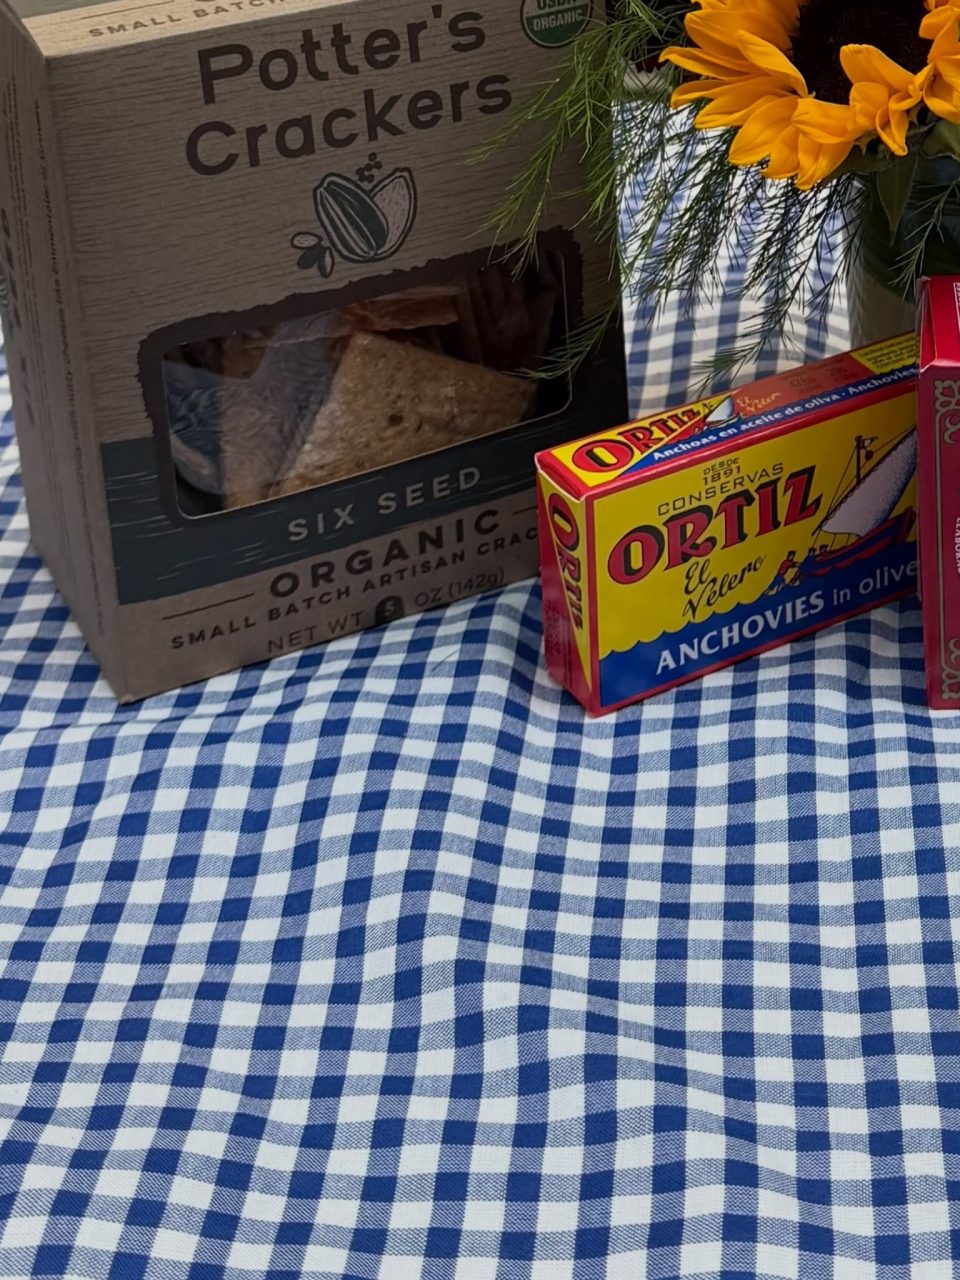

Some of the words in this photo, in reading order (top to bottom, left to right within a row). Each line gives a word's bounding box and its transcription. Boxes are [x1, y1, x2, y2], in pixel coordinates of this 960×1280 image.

[89, 12, 181, 38] SMALL
[532, 5, 585, 32] ORGANIC
[196, 4, 486, 105] Potter's
[185, 74, 512, 176] Crackers
[572, 408, 701, 473] ORTIZ
[653, 435, 718, 461] Anchoas
[719, 426, 738, 438] en
[740, 411, 784, 430] aceite
[785, 405, 802, 416] de
[805, 391, 841, 409] oliva
[657, 463, 785, 517] CONSERVAS
[702, 466, 742, 486] 1891
[703, 458, 740, 475] DESDE
[287, 504, 355, 542] SIX
[377, 467, 483, 515] SEED
[608, 465, 823, 585] ORTIZ
[269, 509, 501, 599] ORGANIC
[682, 553, 767, 619] Velero
[684, 559, 710, 594] El
[171, 616, 256, 650] SMALL
[267, 586, 351, 622] BATCH
[362, 549, 467, 593] ARTISAN
[266, 626, 319, 654] NET
[327, 611, 363, 638] WT
[382, 599, 397, 617] 5
[414, 584, 444, 608] OZ
[446, 566, 507, 604] (142g)
[655, 590, 823, 675] ANCHOVIES
[832, 588, 850, 607] in
[858, 561, 919, 595] olive
